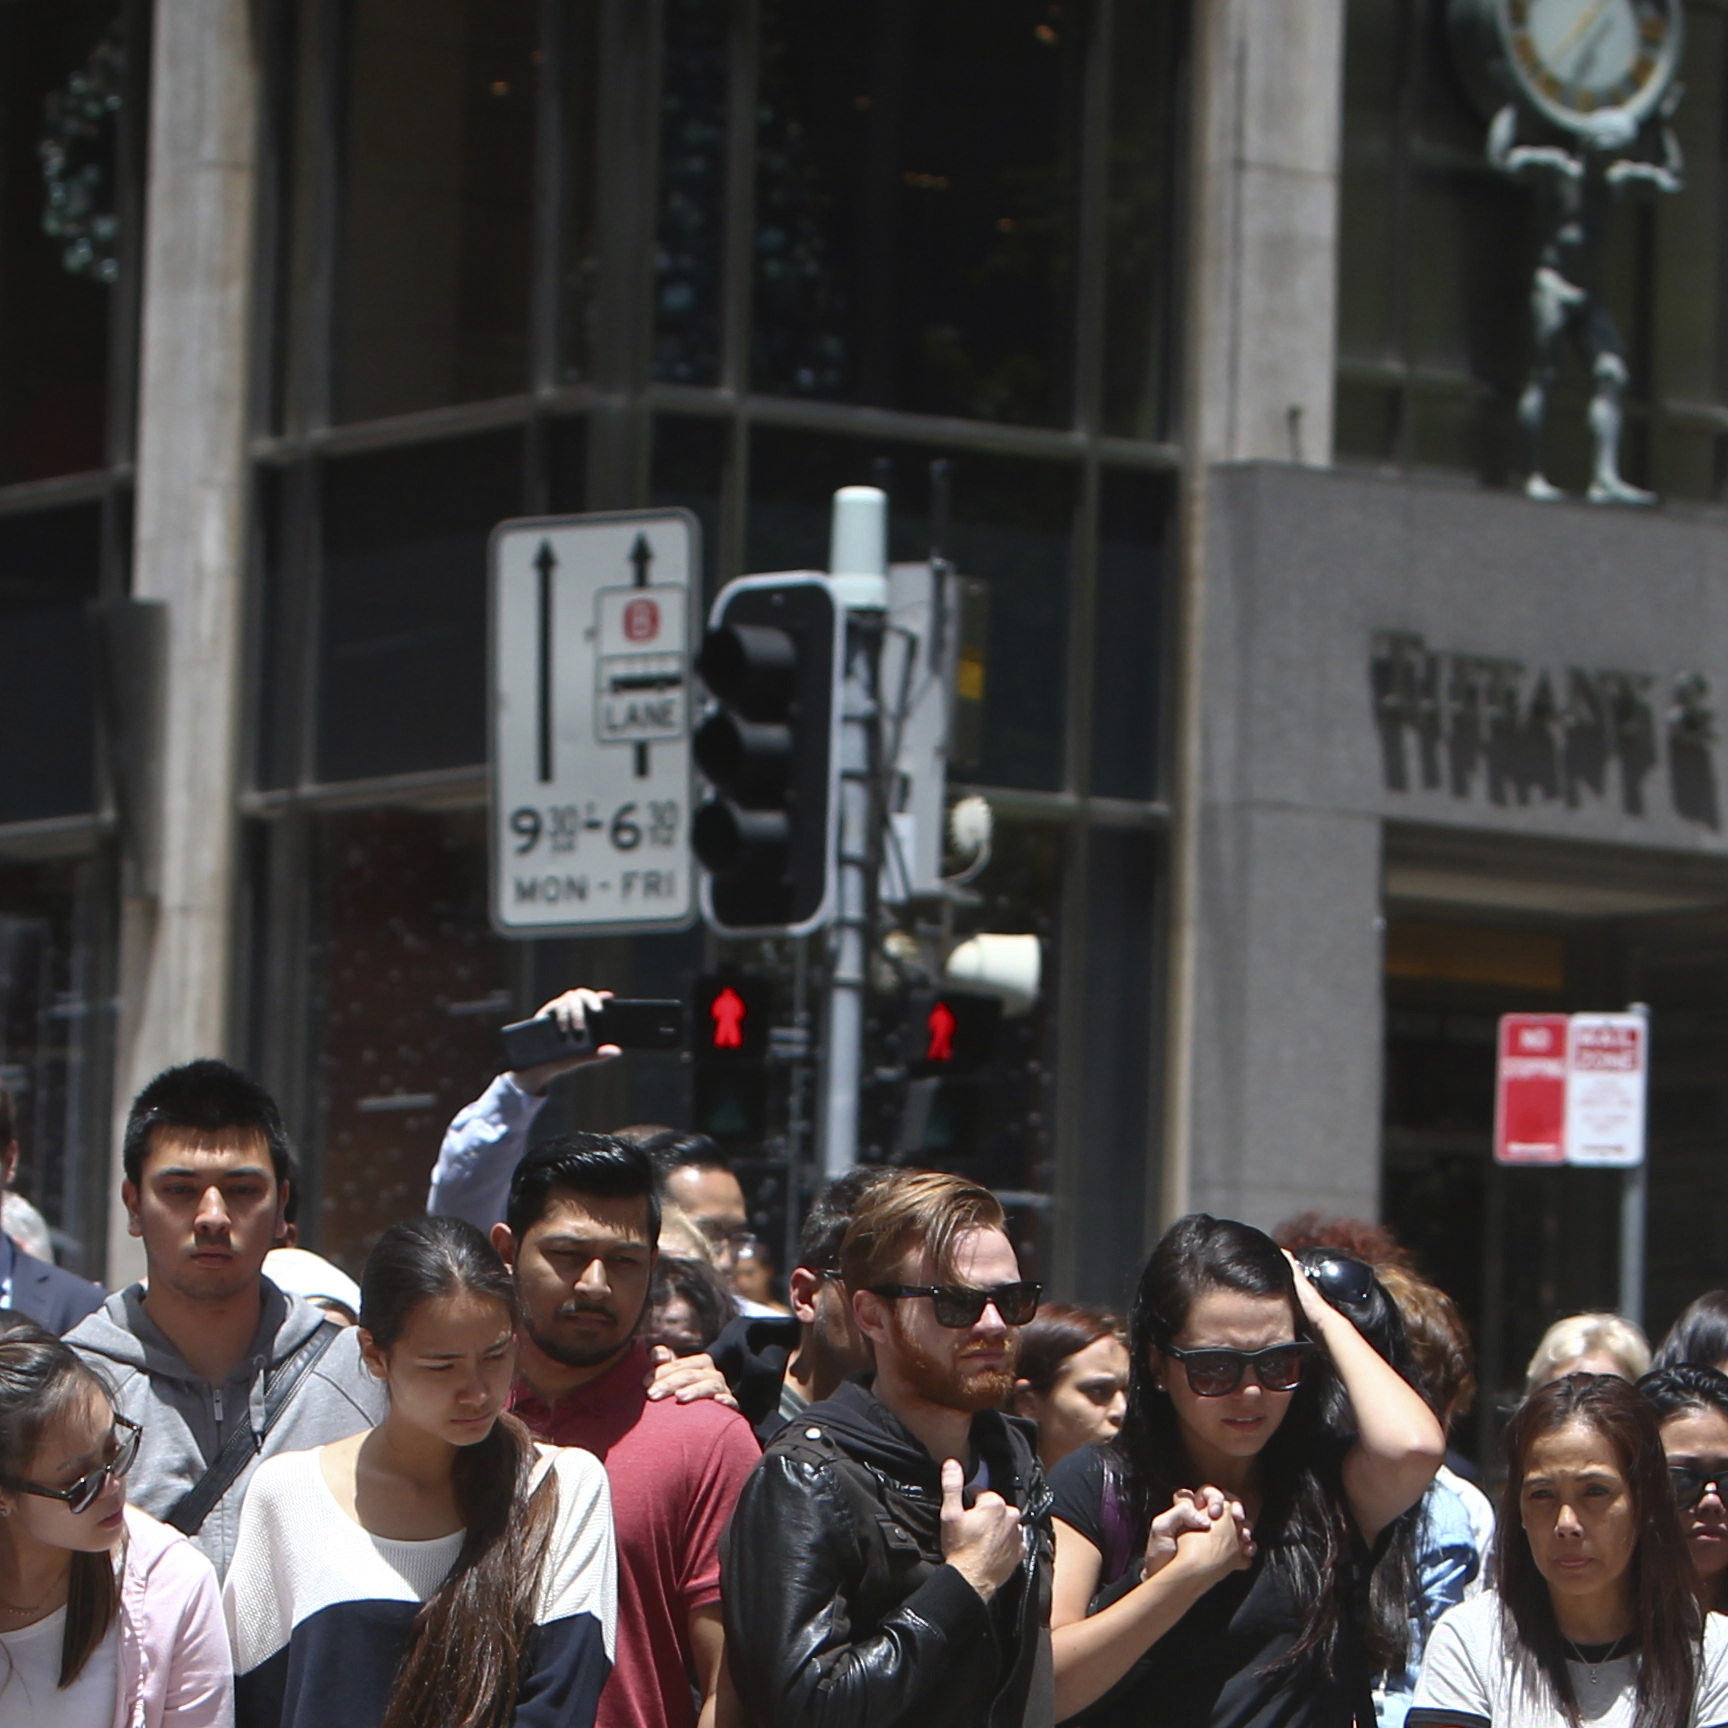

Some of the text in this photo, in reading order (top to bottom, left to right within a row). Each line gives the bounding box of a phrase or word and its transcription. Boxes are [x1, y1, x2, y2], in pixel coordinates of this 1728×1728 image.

[607, 697, 677, 731] LANE
[514, 874, 589, 904] MON
[621, 869, 676, 899] FRI
